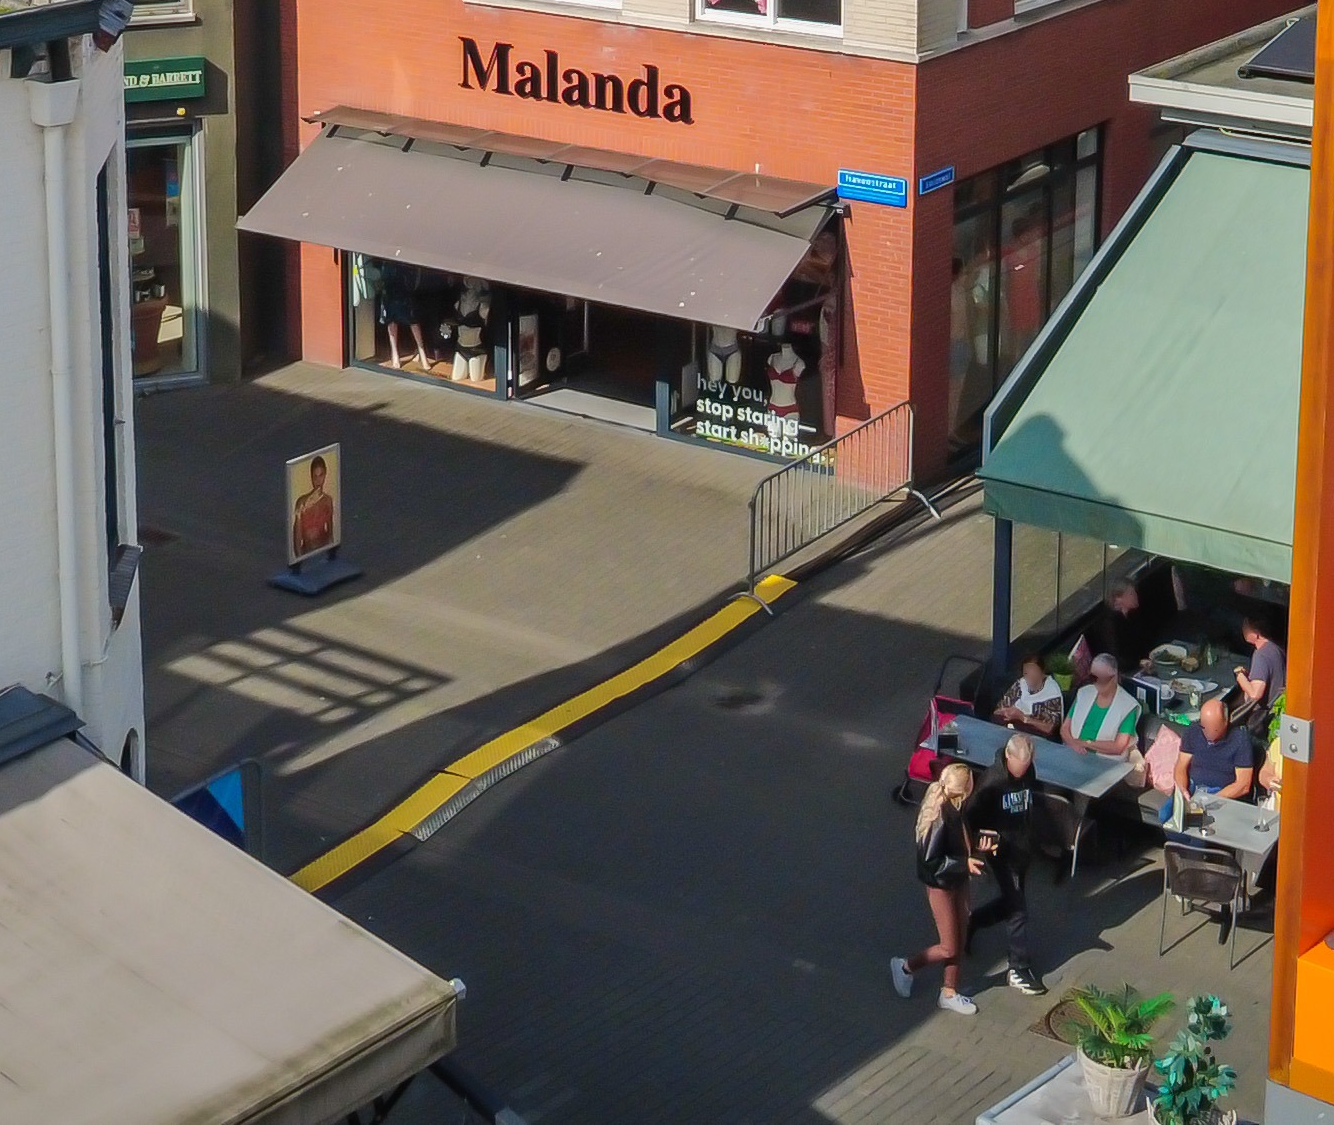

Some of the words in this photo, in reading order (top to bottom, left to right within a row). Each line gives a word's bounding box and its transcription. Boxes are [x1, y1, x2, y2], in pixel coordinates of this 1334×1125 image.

[152, 70, 202, 86] BARRETT
[457, 35, 695, 125] Malanda
[697, 372, 727, 399] hey
[696, 397, 734, 421] stop
[696, 419, 737, 442] start
